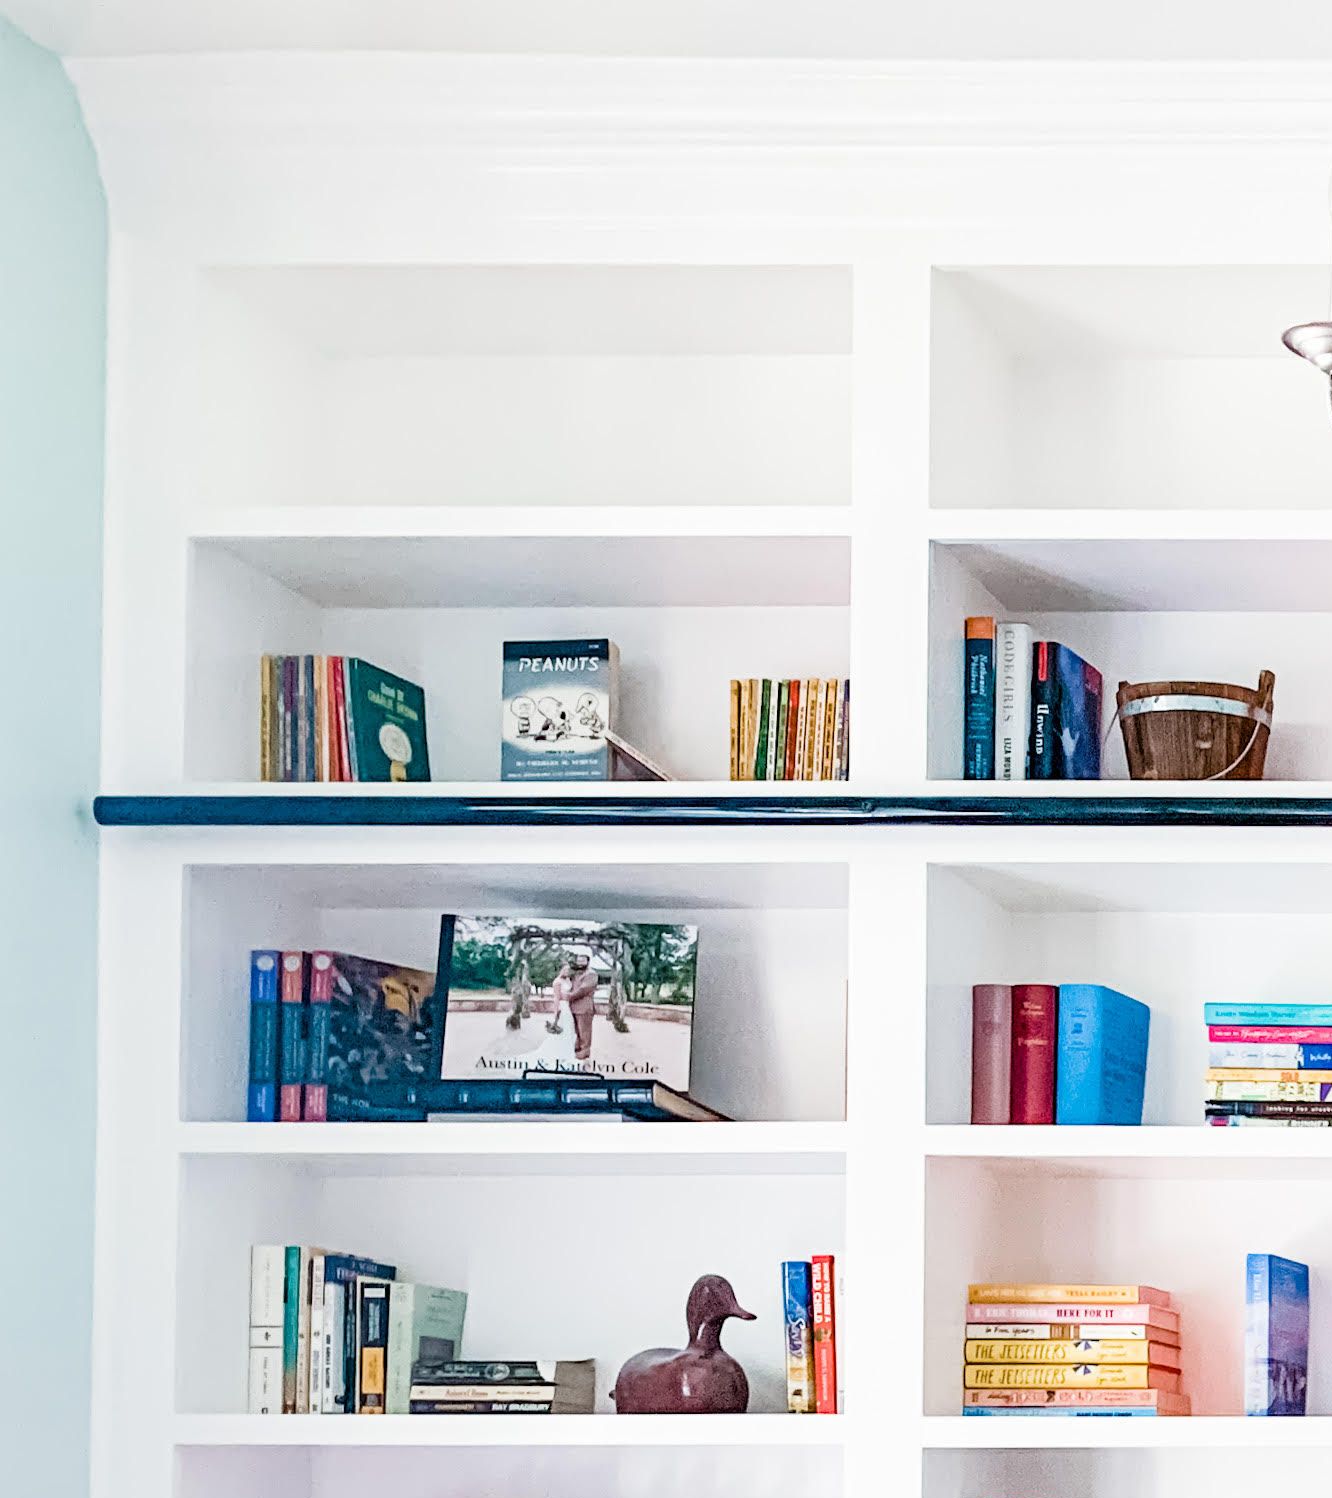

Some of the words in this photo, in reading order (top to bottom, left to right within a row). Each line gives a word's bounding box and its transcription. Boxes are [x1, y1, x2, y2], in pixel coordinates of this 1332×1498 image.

[519, 656, 599, 673] PEANUTS
[1004, 631, 1015, 673] CODE
[1003, 676, 1015, 722] GIRLS
[475, 1056, 531, 1073] Austin
[624, 1060, 659, 1076] Cole
[812, 1263, 821, 1289] WILD
[813, 1291, 822, 1323] CHILD
[975, 1345, 995, 1361] THE
[1000, 1345, 1067, 1361] JETSETTERS
